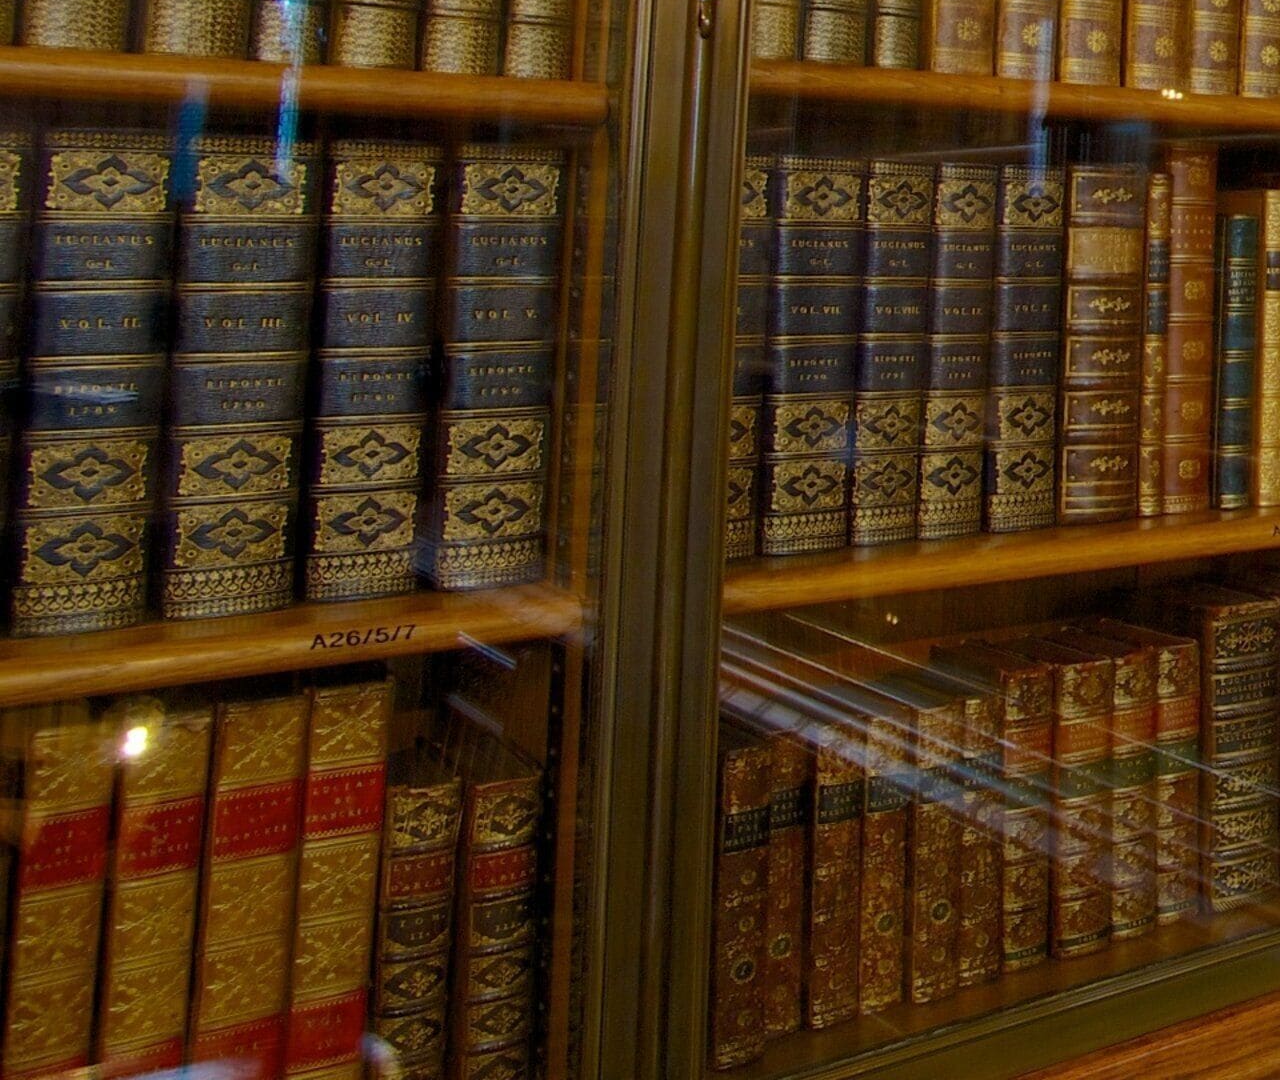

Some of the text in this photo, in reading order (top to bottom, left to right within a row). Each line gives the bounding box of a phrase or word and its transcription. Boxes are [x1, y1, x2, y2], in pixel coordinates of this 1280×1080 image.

[54, 235, 155, 247] LUCIANUS
[200, 237, 295, 248] LUCIANUS
[341, 236, 423, 247] LUCIANUS
[472, 236, 547, 247] LUCIANUS
[791, 239, 849, 250] LUCIANUS
[310, 624, 417, 652] A26/5/7
